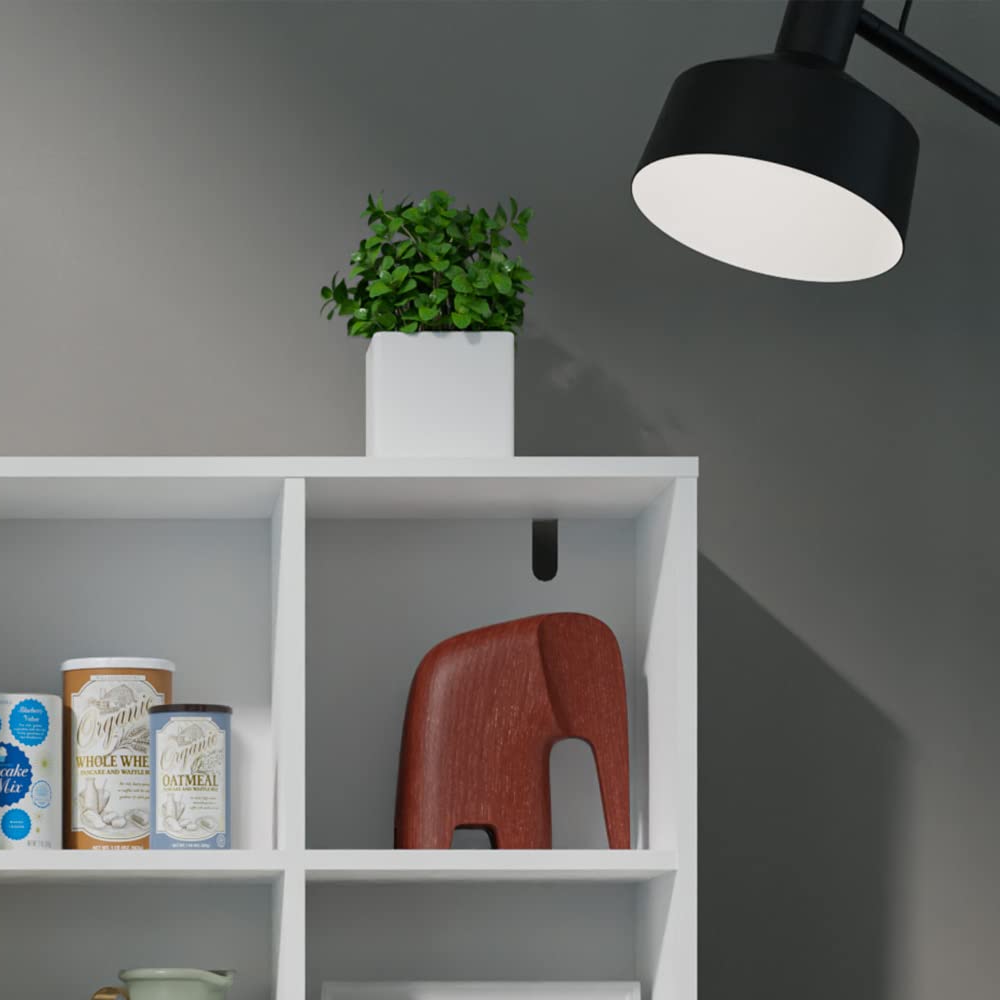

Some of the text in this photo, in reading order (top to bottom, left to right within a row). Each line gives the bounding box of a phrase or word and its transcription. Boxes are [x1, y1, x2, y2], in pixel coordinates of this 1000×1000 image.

[76, 694, 153, 753] Organic
[76, 755, 150, 768] WHOLE WHE
[159, 731, 218, 771] Organic
[162, 774, 219, 787] OATMEAL
